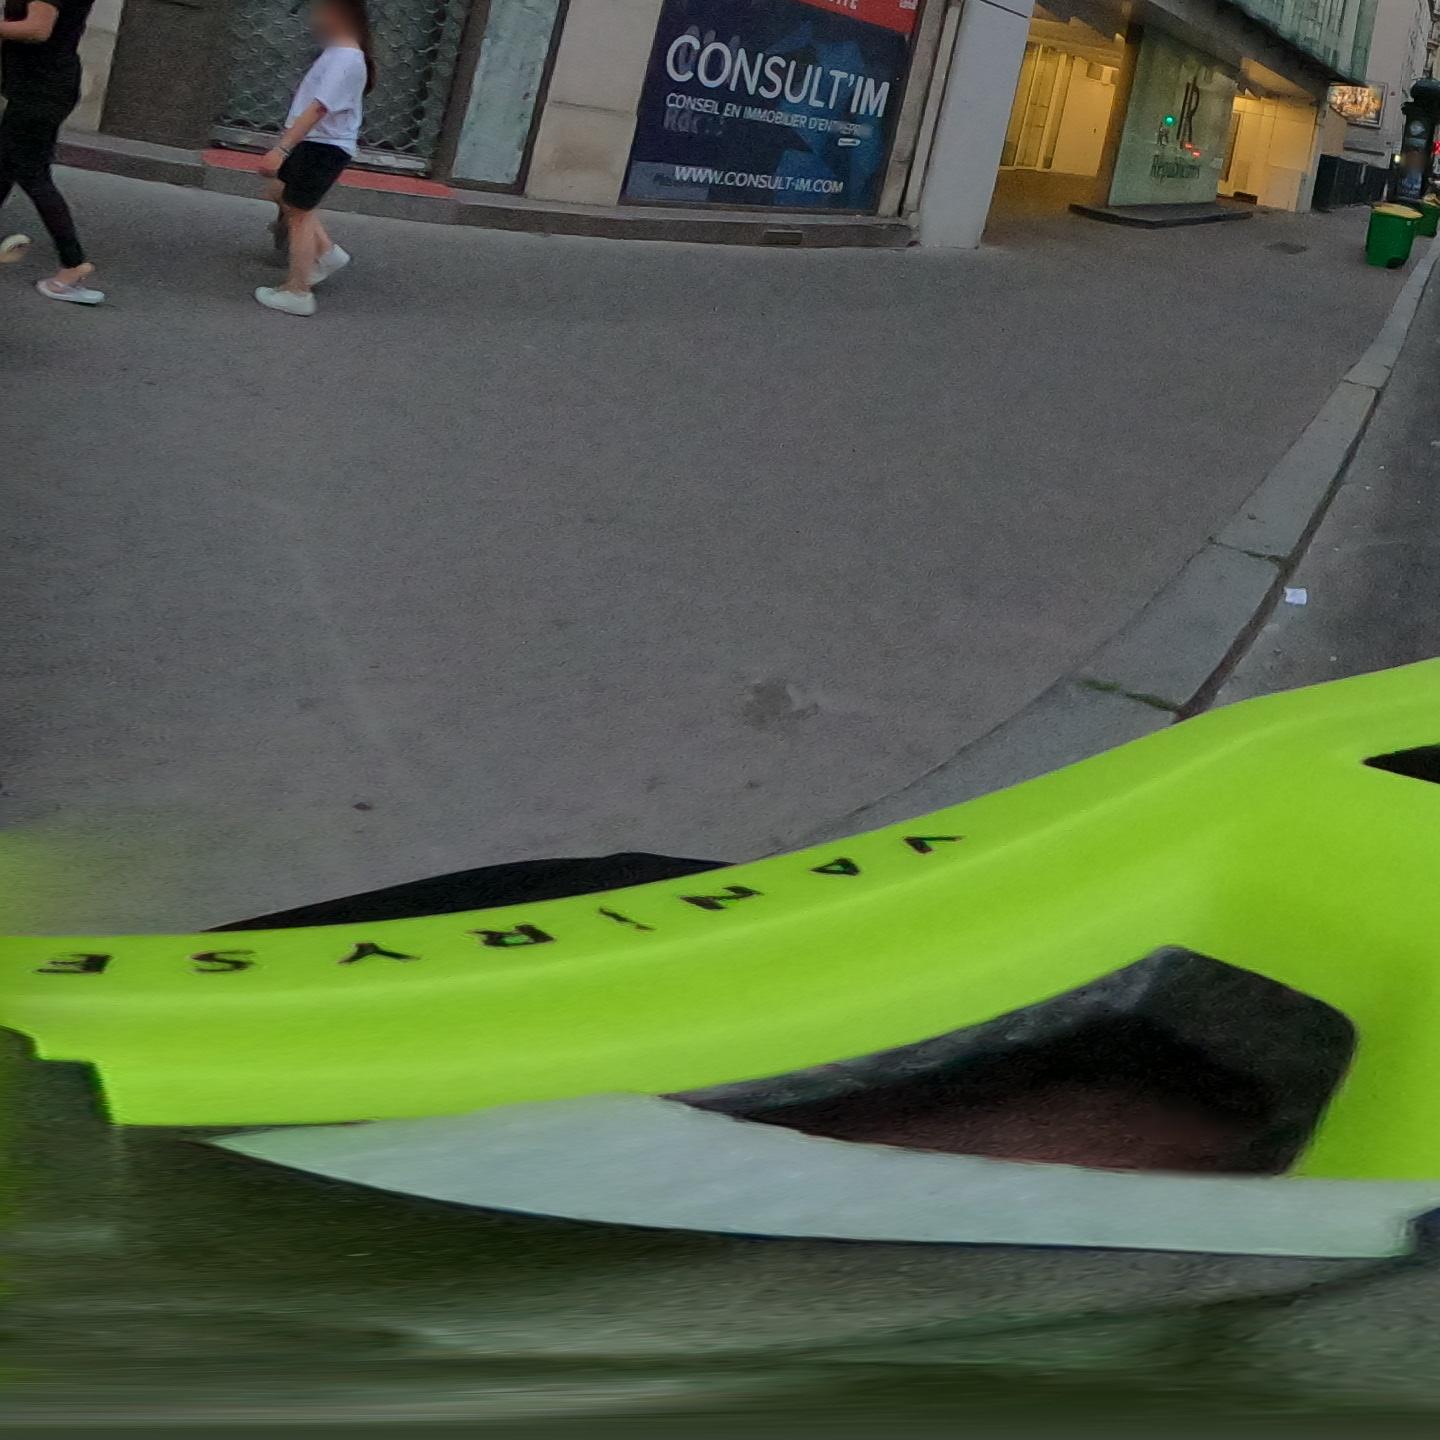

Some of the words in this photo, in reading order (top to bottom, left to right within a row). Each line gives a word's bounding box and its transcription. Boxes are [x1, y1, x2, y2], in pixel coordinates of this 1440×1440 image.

[666, 34, 890, 117] CONSULT'IM
[666, 93, 720, 115] CONSEIL
[723, 102, 740, 118] EN
[743, 106, 808, 129] IMMOBILIER
